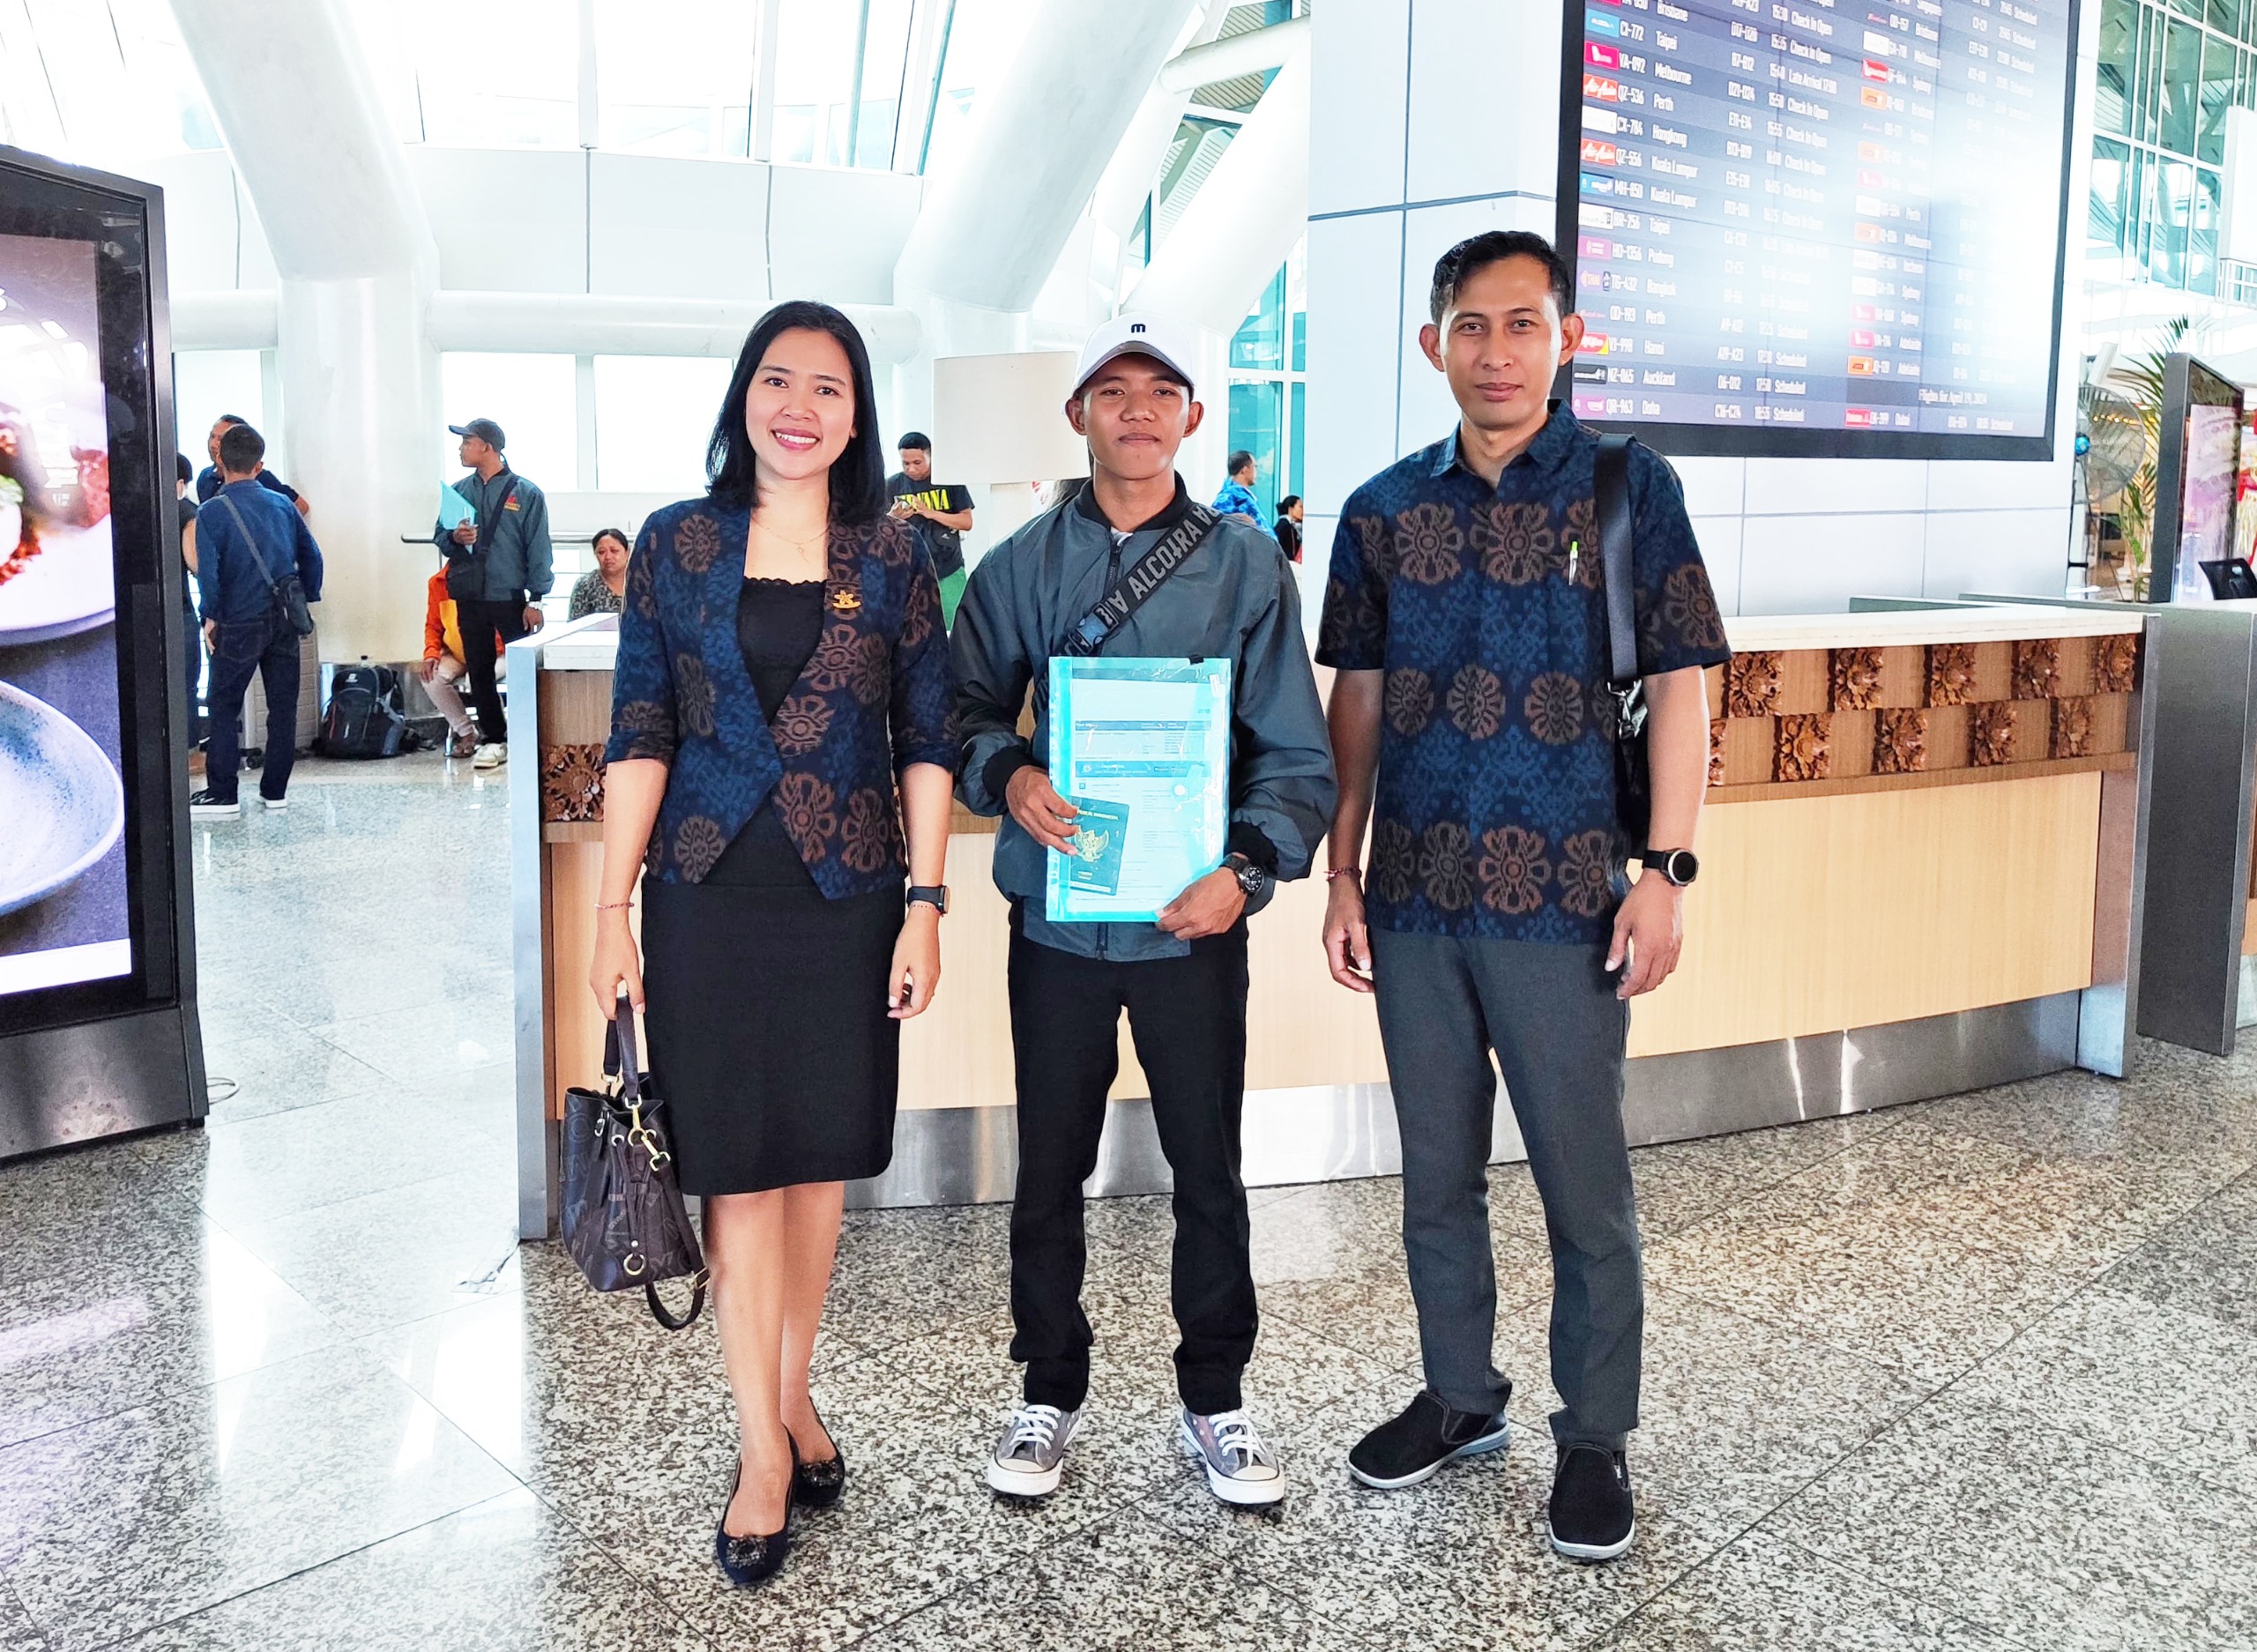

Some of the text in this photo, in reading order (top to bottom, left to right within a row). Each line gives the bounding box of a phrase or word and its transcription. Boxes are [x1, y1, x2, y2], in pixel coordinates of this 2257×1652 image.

[1620, 20, 1646, 41] CI-772
[1656, 30, 1679, 51] Taipei
[1657, 1, 1689, 22] Brisbane
[1816, 48, 1832, 65] Open
[1817, 19, 1834, 36] Open
[1619, 52, 1647, 74] VA-092
[1654, 62, 1693, 86] Melbourne
[1813, 104, 1829, 121] Open
[1653, 93, 1675, 111] Perth
[1651, 154, 1672, 173] Kuala
[1672, 159, 1699, 180] Lumpur
[1650, 186, 1671, 205] Kuala
[1672, 190, 1698, 210] Lumpur
[1649, 217, 1672, 236] Taipei
[1647, 278, 1677, 298] Bangkok
[1645, 309, 1666, 325] Perth
[1643, 339, 1665, 356] Hanoi
[1642, 368, 1676, 386] Auckland
[1774, 379, 1806, 395] Scheduled
[1918, 389, 1938, 406] Flights
[1940, 390, 1948, 402] for
[1948, 391, 1964, 406] April
[1606, 397, 1634, 415] QR-963
[1642, 399, 1661, 416] Doha
[1773, 406, 1806, 423] Scheduled
